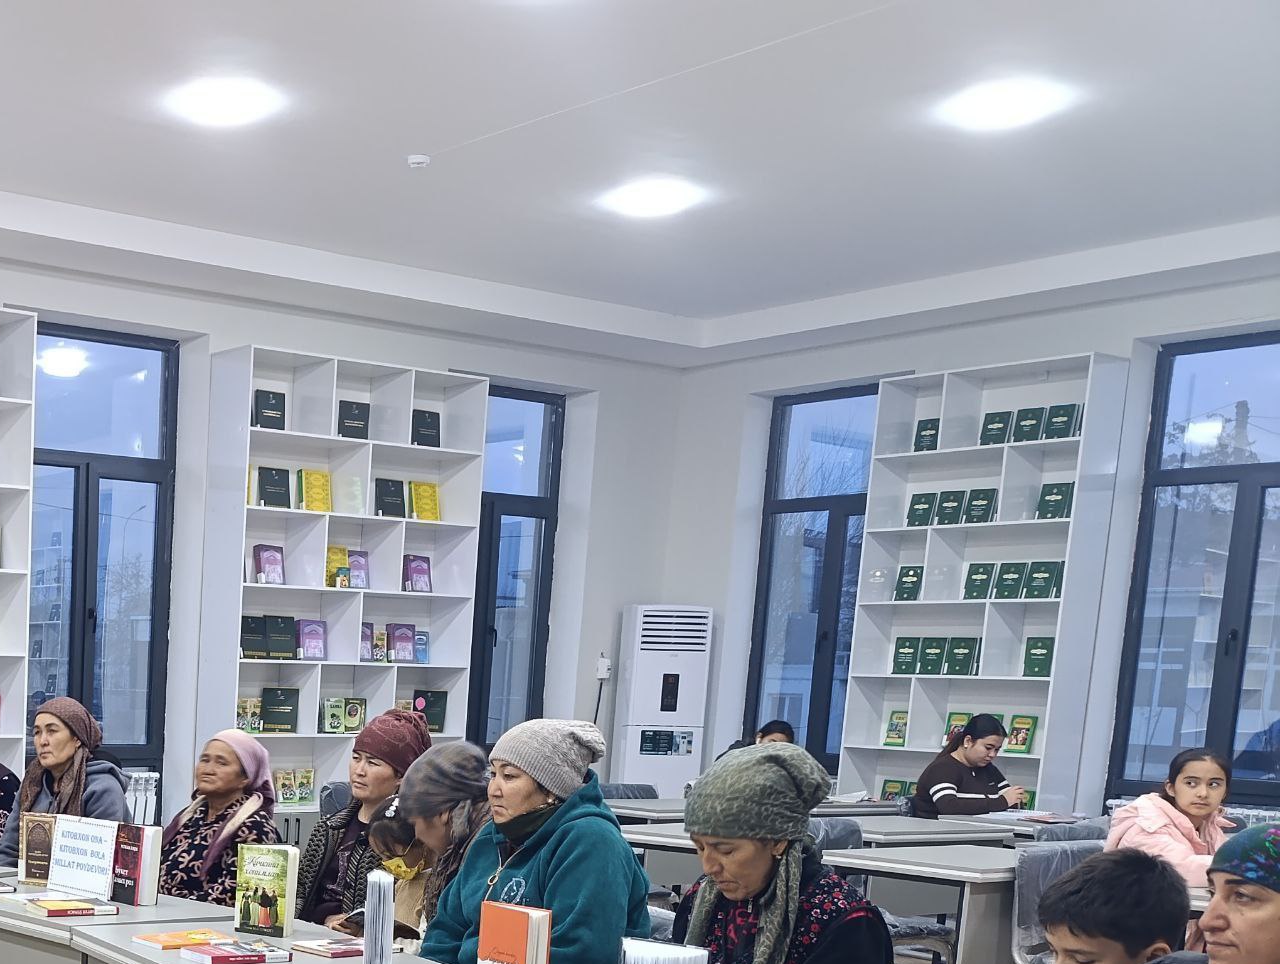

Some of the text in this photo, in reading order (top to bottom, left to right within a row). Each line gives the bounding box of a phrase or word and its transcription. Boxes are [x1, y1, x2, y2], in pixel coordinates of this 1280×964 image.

[61, 830, 90, 842] KITOBXON
[59, 844, 106, 861] KITOBXON BOLA
